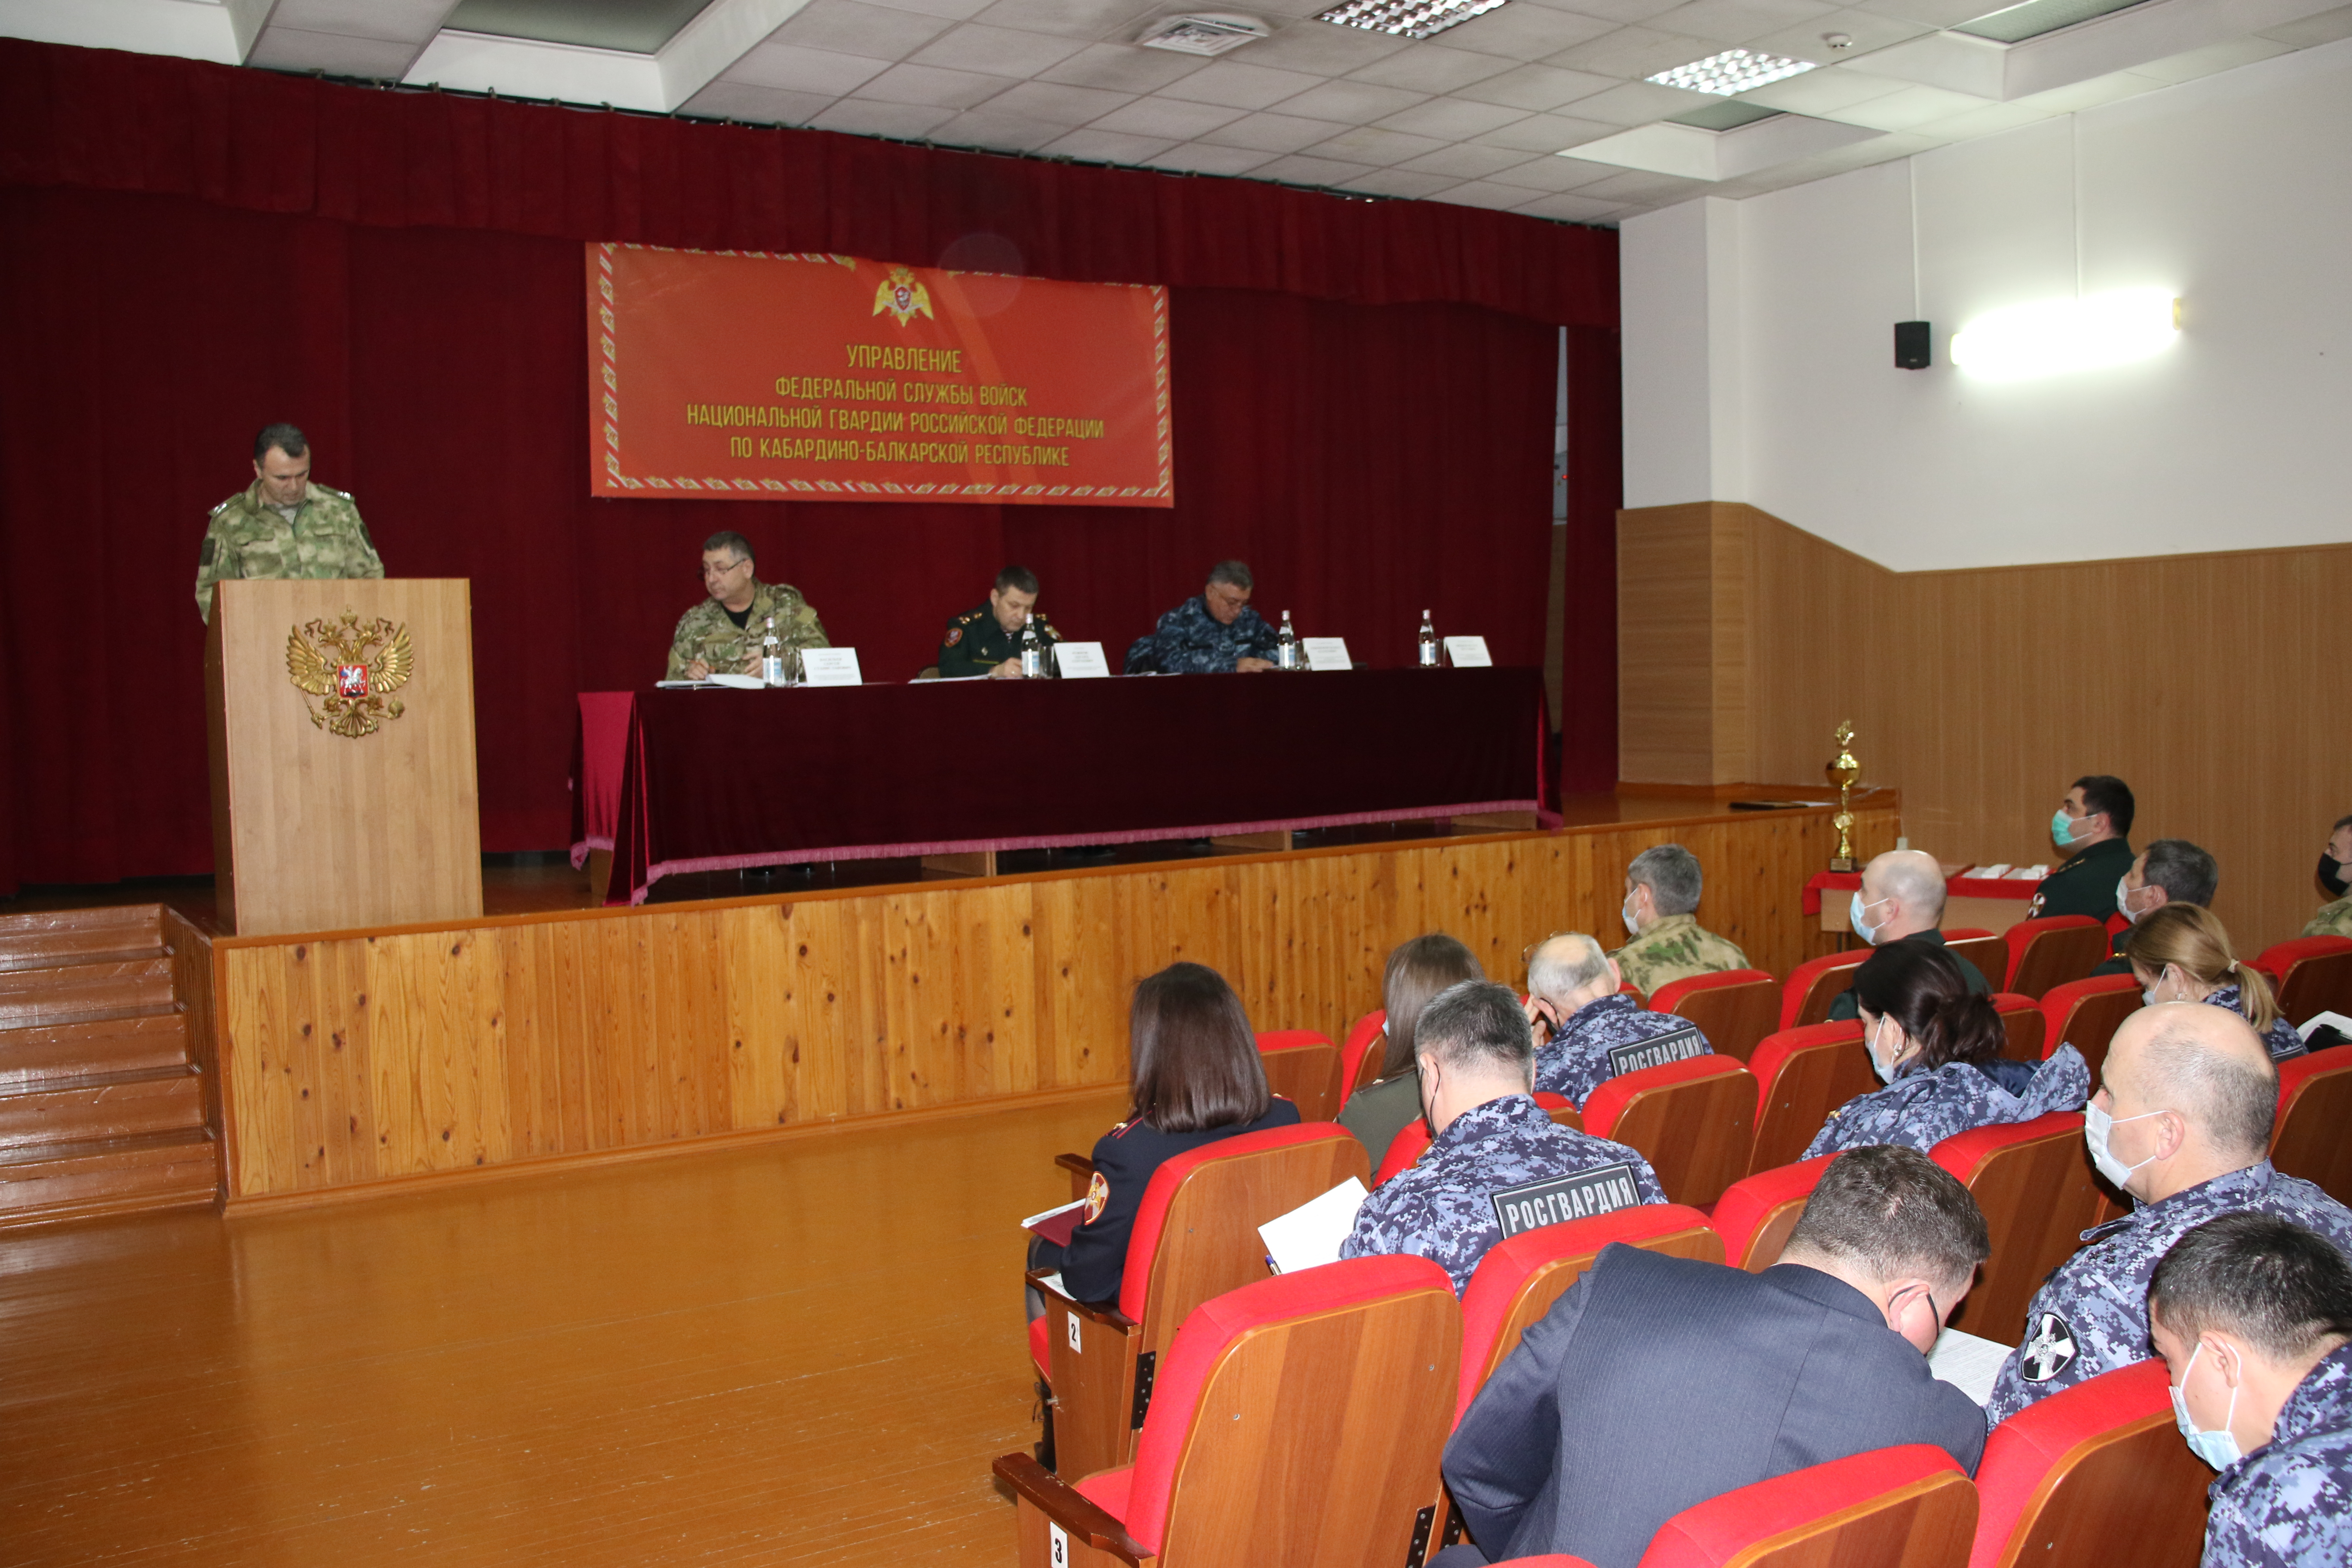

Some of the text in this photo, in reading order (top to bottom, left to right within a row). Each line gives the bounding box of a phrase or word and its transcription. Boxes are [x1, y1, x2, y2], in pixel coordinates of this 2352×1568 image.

[846, 344, 962, 373] УПРАВЛЕНИЕ
[775, 377, 1028, 407] ФЕДЕРАЛЬНОЙ СЛУЖБЫ ВОЙСК
[688, 404, 1104, 440] НАЦИОНАЛЬНОЙ ГВАРДИИ РОССИЙСКОЙ ФЕДЕРАЦИИ
[731, 436, 1069, 466] ПО КАБАРДИНО-БАЛКАРСКОЙ РЕСПУБЛИКЕ
[1618, 1035, 1701, 1075] РОСГВАРДИЯ
[1505, 1177, 1633, 1233] РОСГВАРДИЯ
[1071, 1323, 1076, 1342] 2
[1055, 1537, 1062, 1564] 3
